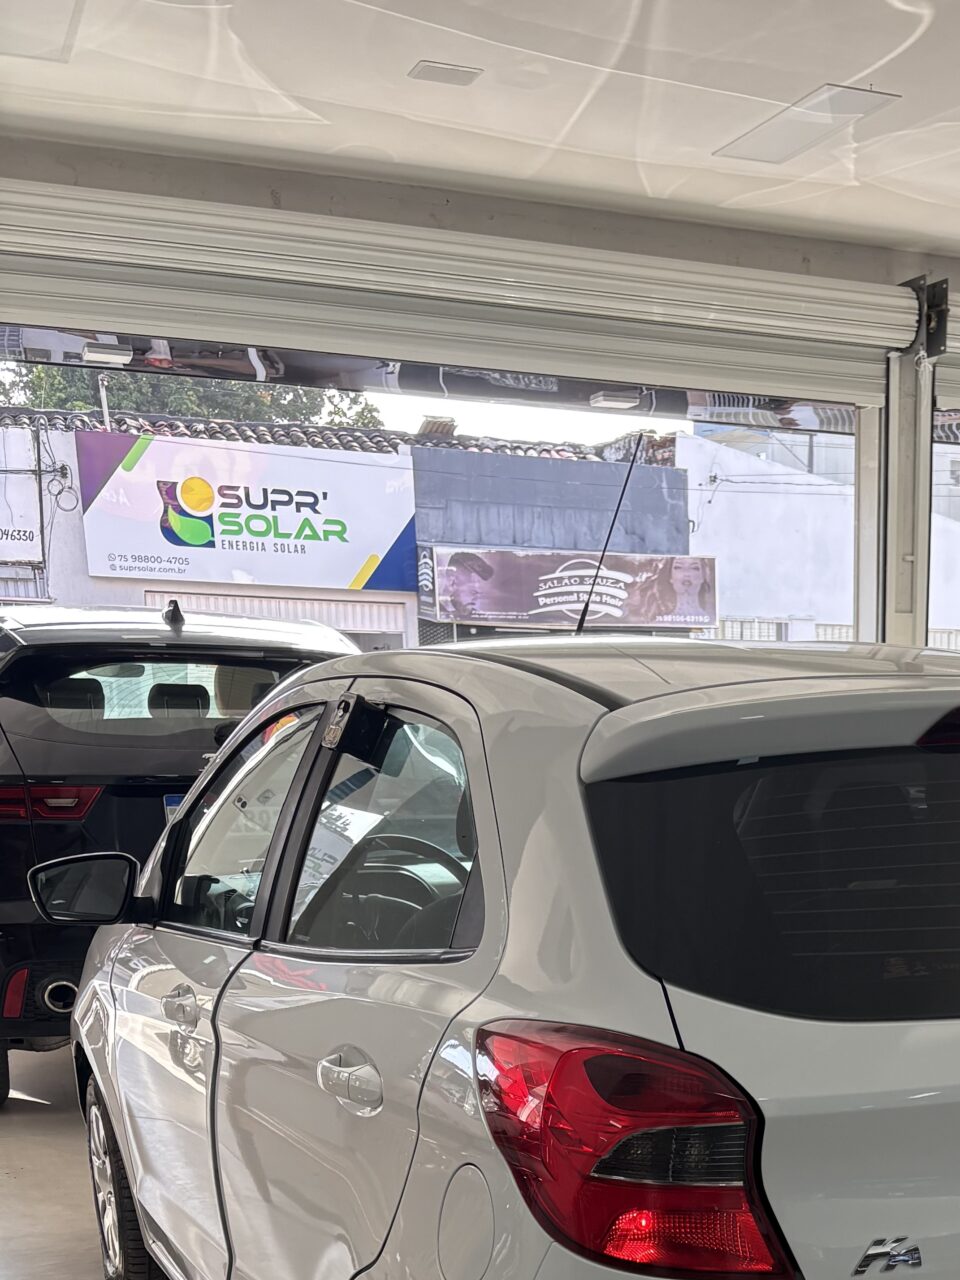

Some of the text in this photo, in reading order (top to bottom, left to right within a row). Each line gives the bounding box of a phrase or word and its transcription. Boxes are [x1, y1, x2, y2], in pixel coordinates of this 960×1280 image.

[217, 512, 350, 543] SOLAR
[221, 539, 307, 554] ENERGIA SOLAR
[117, 554, 190, 566] 75 98800-4705
[118, 564, 187, 574] suprsolar.com.br
[538, 576, 580, 591] SALÃO
[538, 593, 578, 606] Personal
[602, 594, 624, 607] Hair
